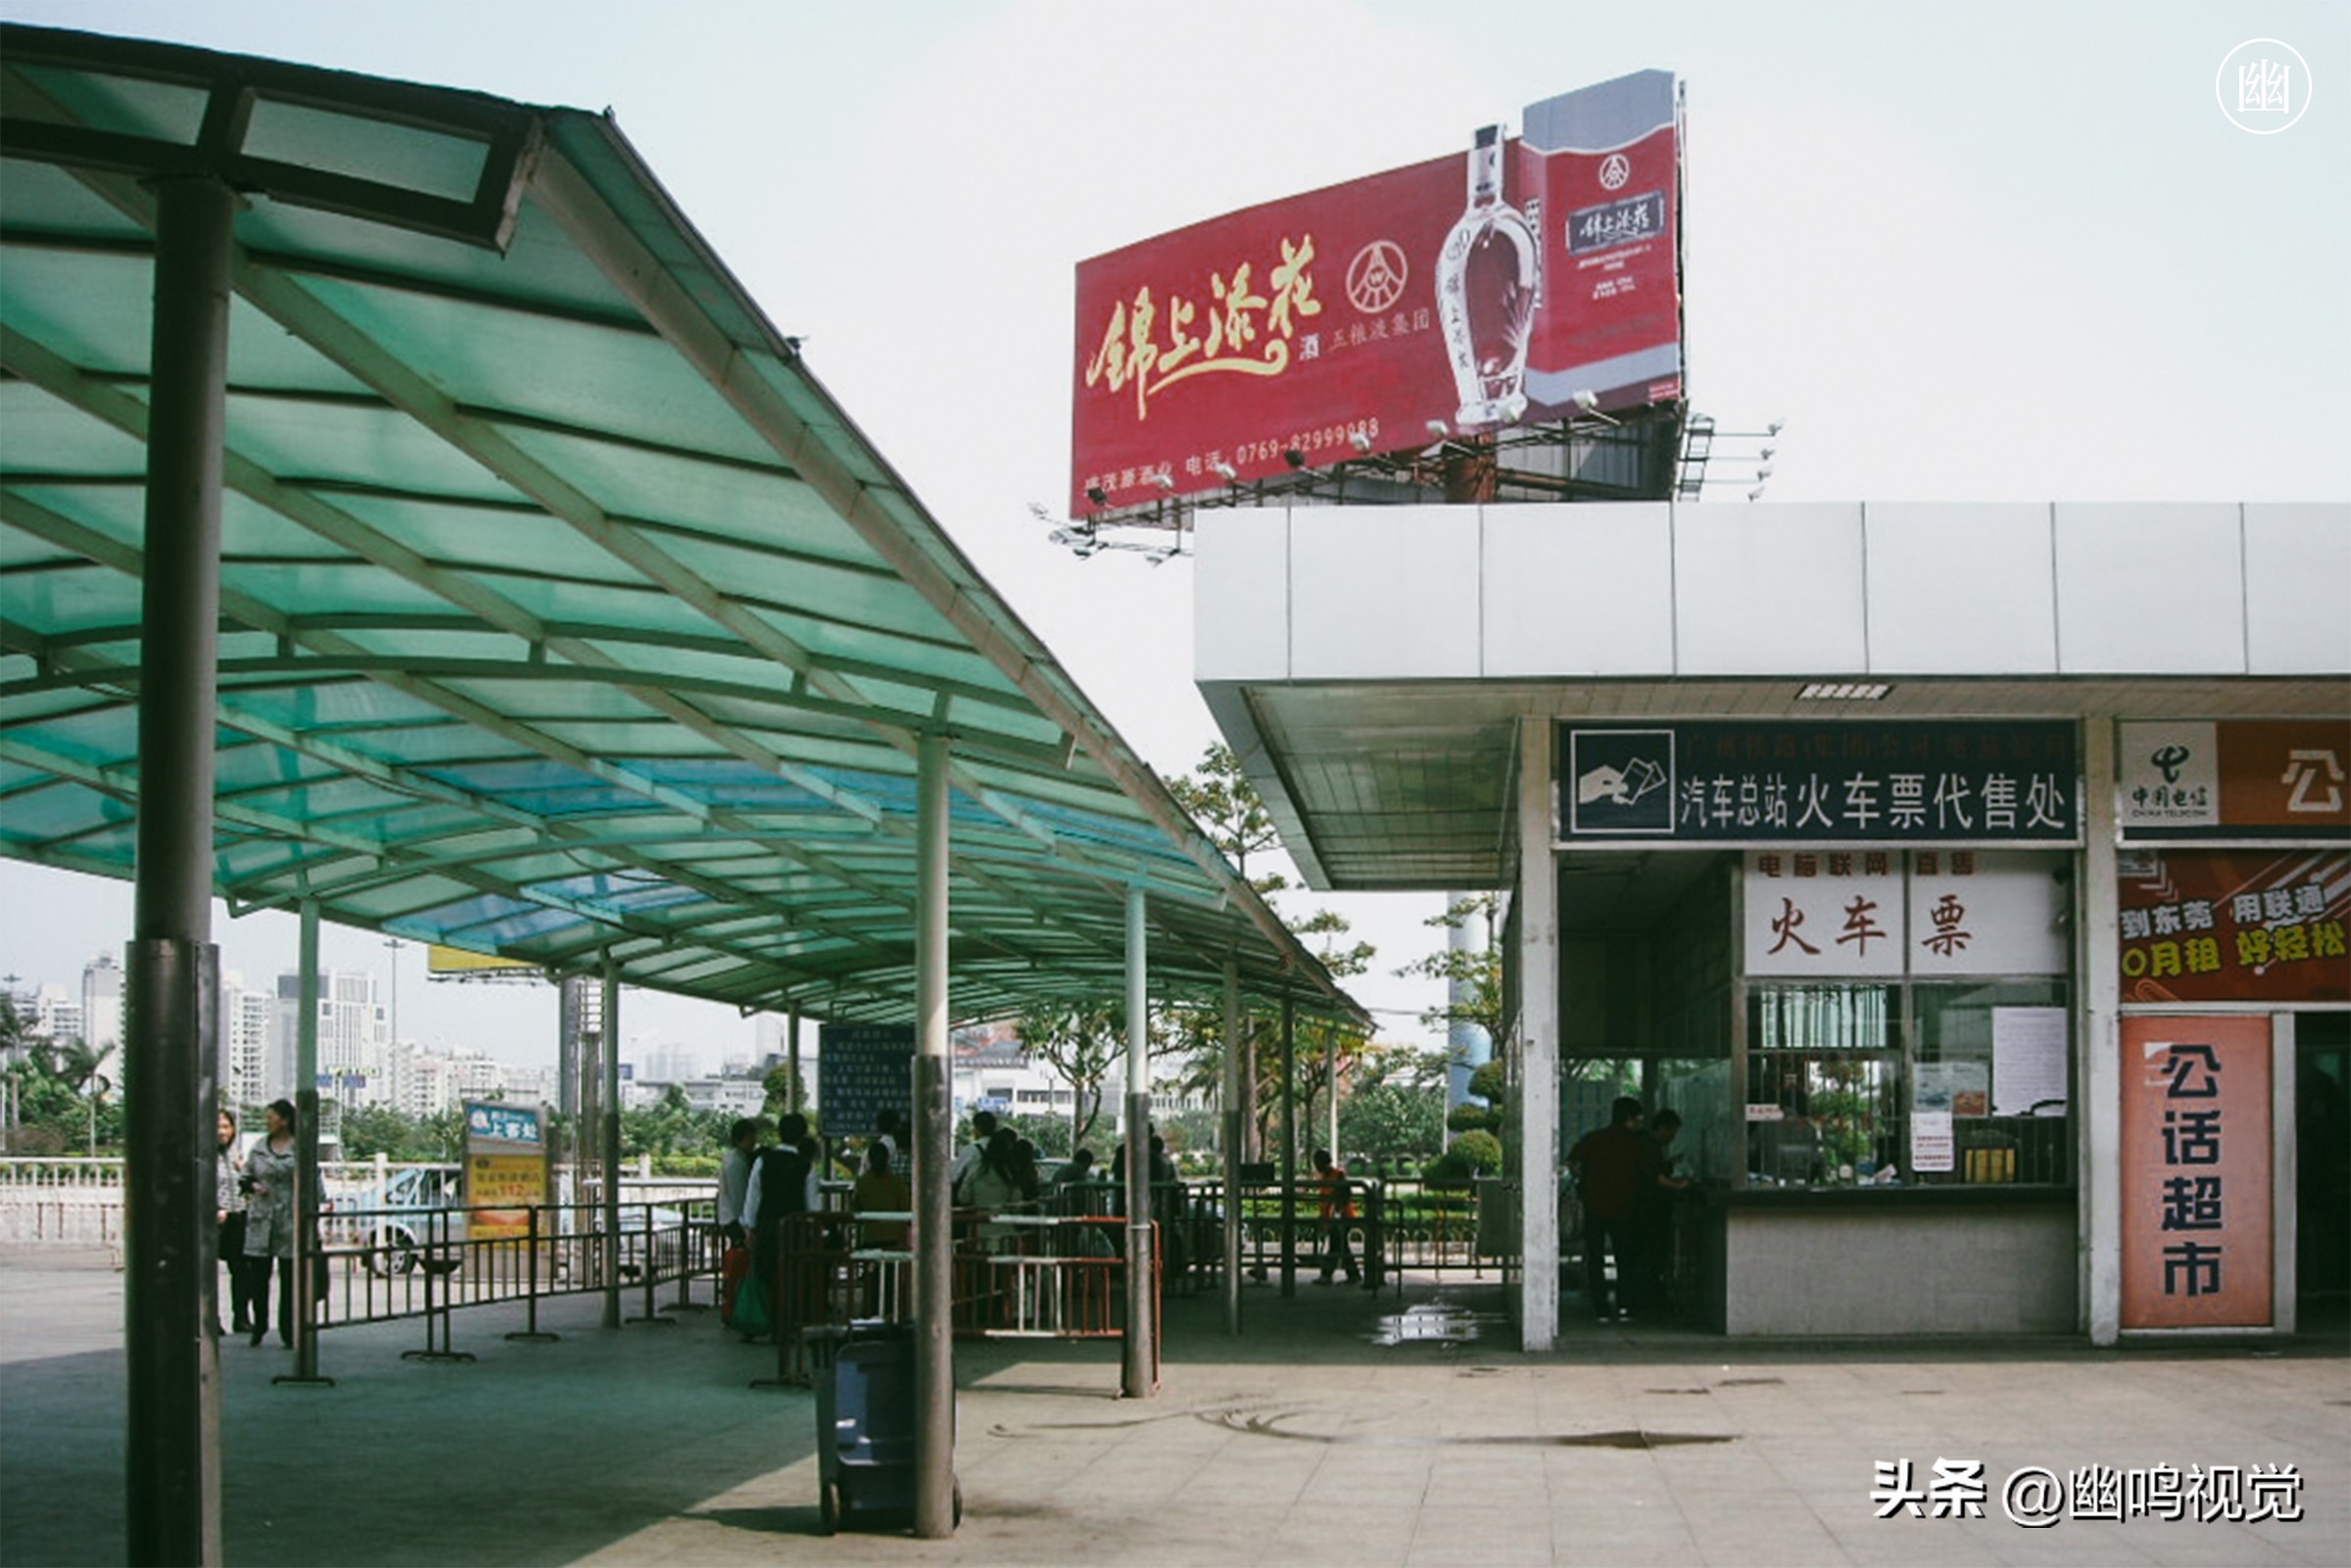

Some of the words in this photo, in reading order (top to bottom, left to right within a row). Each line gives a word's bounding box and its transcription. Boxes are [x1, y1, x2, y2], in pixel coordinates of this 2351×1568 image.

[1085, 233, 1321, 421] 锦上添花
[2132, 785, 2207, 808] 中国电信
[2281, 749, 2345, 812] 公
[1767, 893, 1973, 958] 火车票
[2120, 899, 2214, 940] 到东莞
[2232, 883, 2327, 925] 用联通
[2236, 920, 2347, 966] 好轻松
[2161, 1043, 2223, 1297] 公话超市
